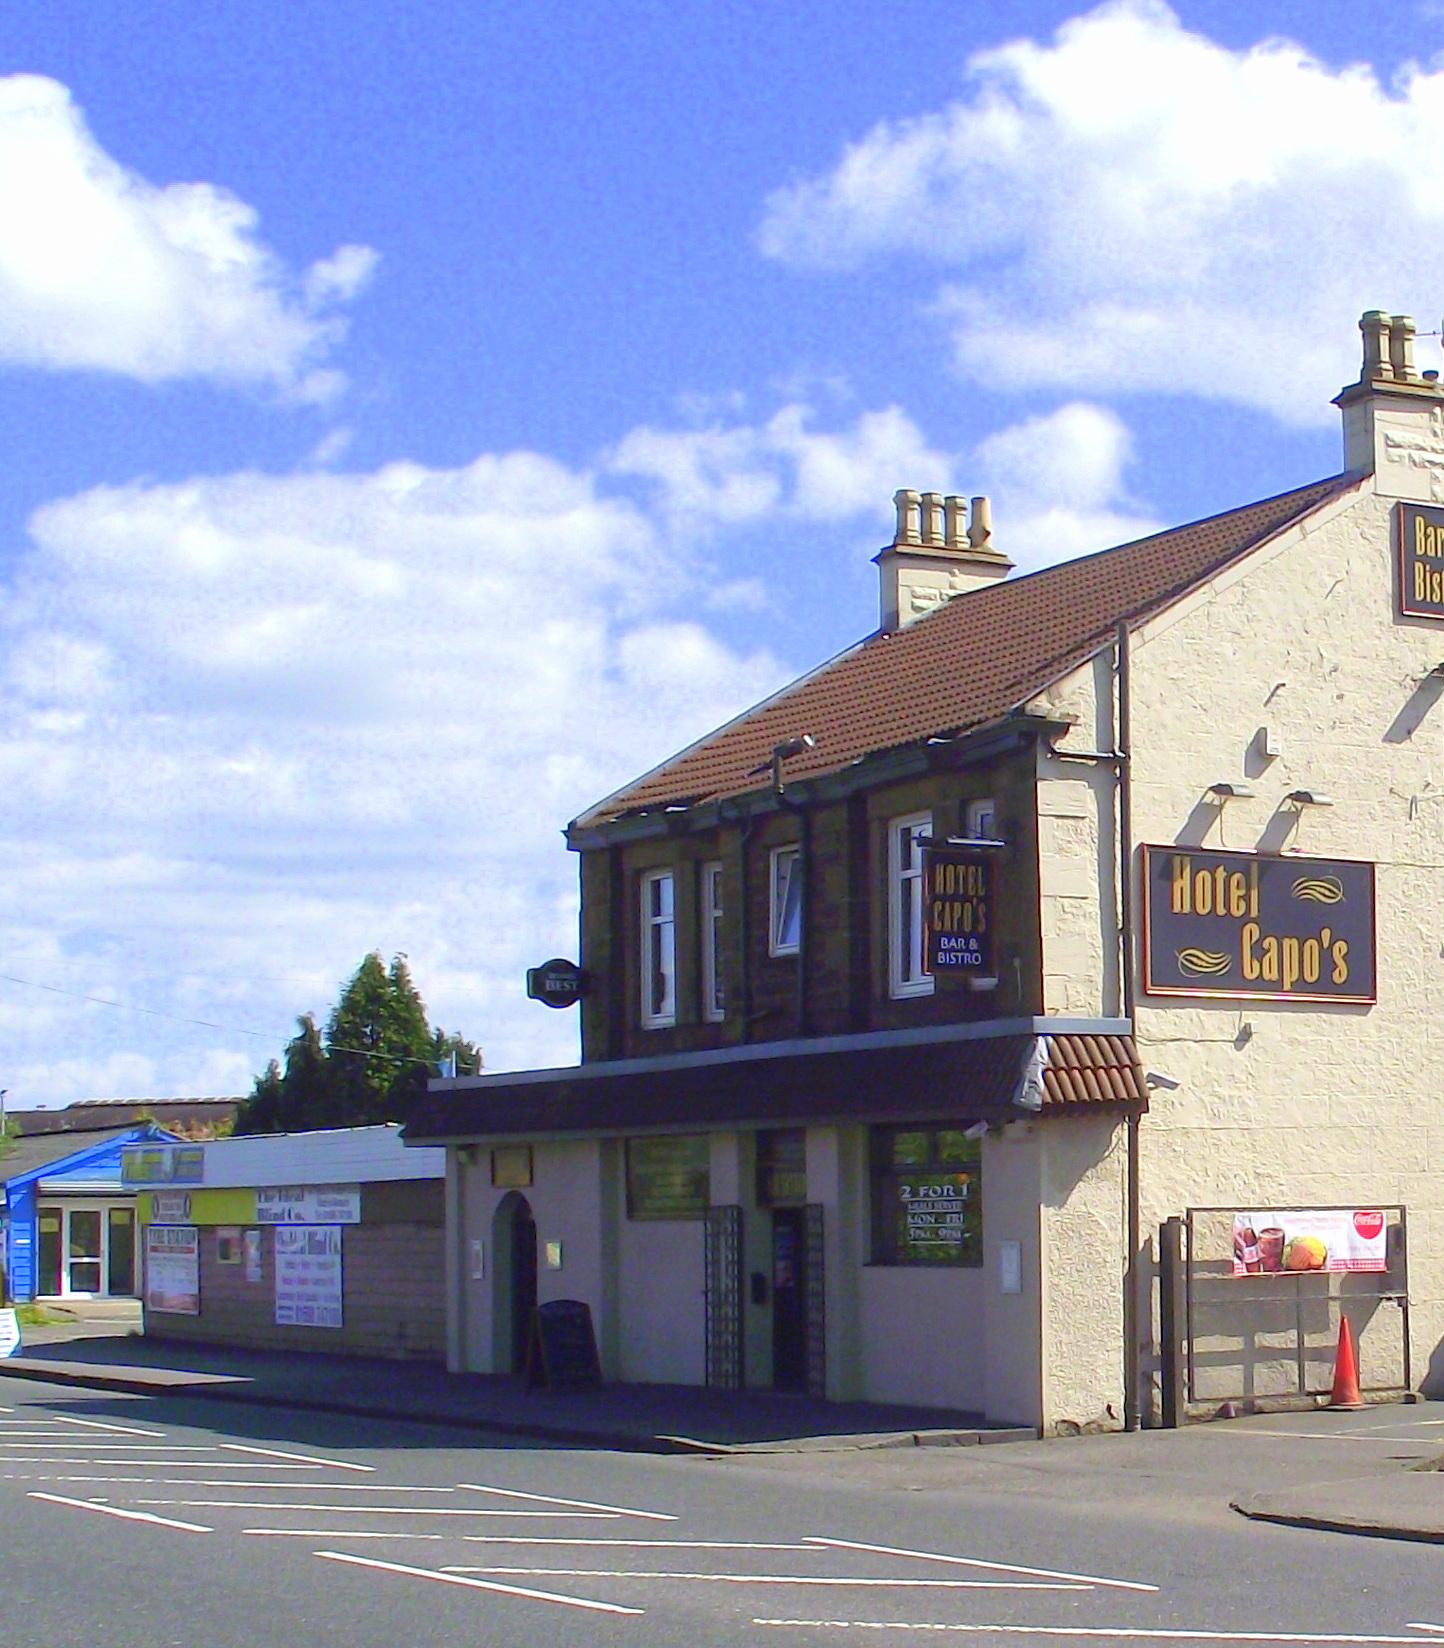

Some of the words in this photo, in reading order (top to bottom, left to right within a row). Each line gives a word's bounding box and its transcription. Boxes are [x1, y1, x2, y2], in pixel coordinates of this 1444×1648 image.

[935, 863, 985, 896] HOTEL
[1171, 855, 1260, 919] Hotel
[934, 897, 986, 933] CAPO'S
[940, 937, 966, 950] BAR
[969, 938, 979, 950] &
[937, 952, 982, 965] BISTRO
[1241, 922, 1349, 991] Capo's
[901, 1185, 912, 1198] 2
[919, 1185, 956, 1197] FOR
[961, 1183, 968, 1197] 1
[907, 1213, 935, 1225] MON
[946, 1213, 964, 1224] FRI
